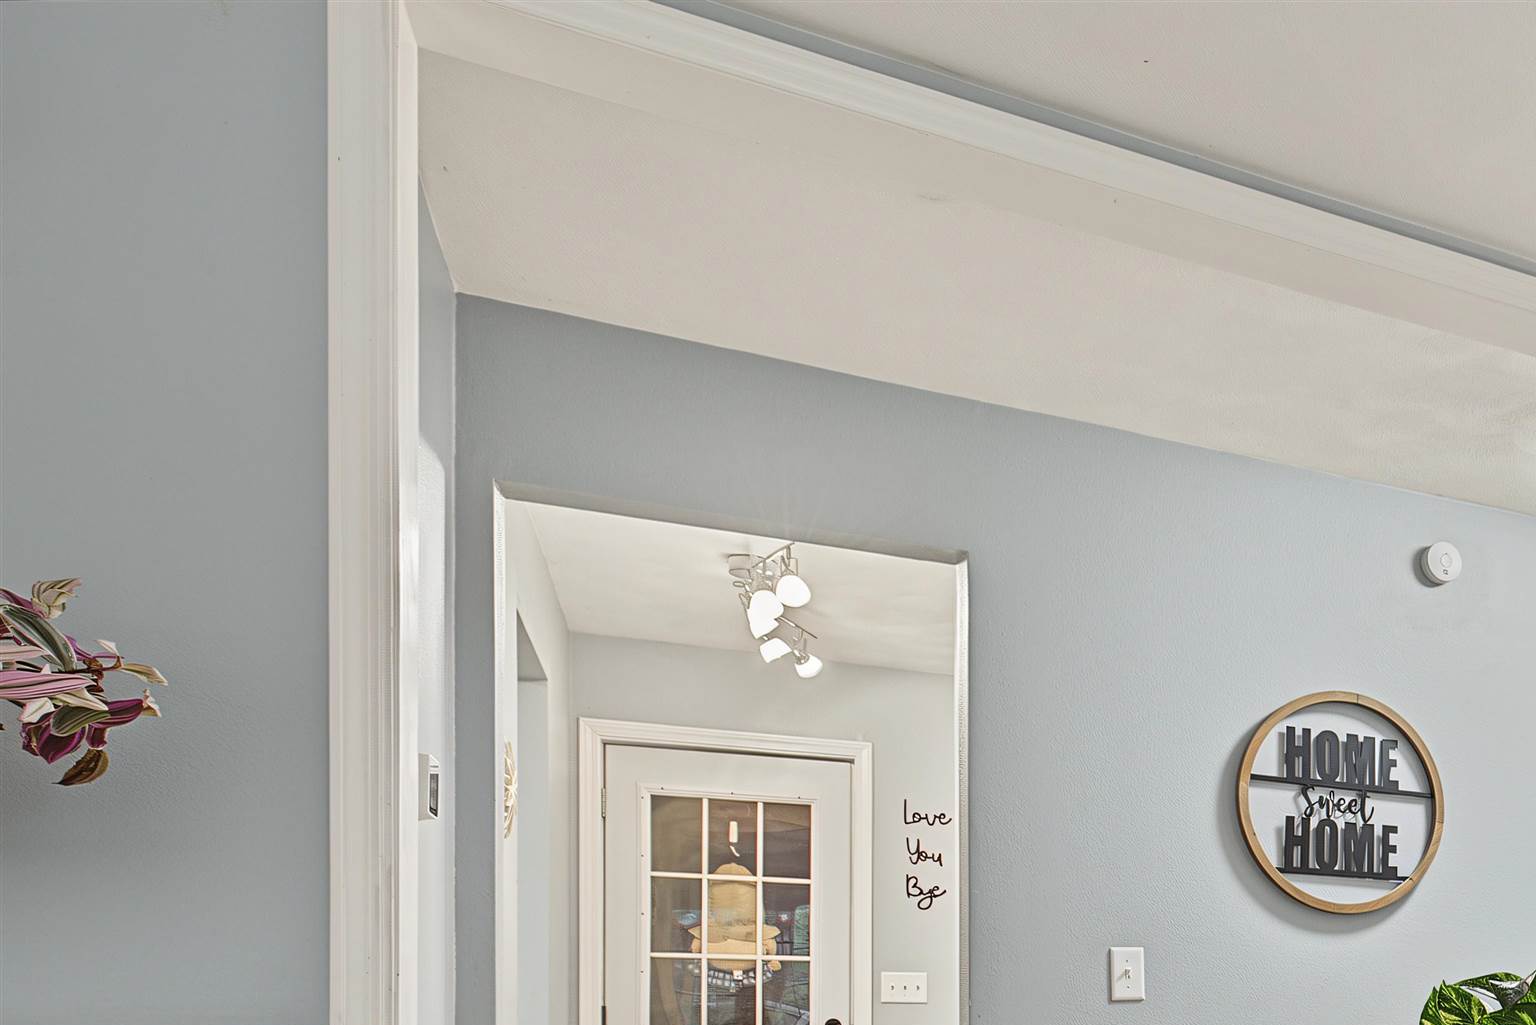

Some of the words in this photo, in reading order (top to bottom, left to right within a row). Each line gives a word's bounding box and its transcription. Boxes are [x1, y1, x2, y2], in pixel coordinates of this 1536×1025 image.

[1285, 726, 1399, 790] HOME
[904, 799, 952, 826] Love
[906, 837, 943, 867] You
[1284, 816, 1399, 878] HOME
[906, 874, 946, 910] Bye
